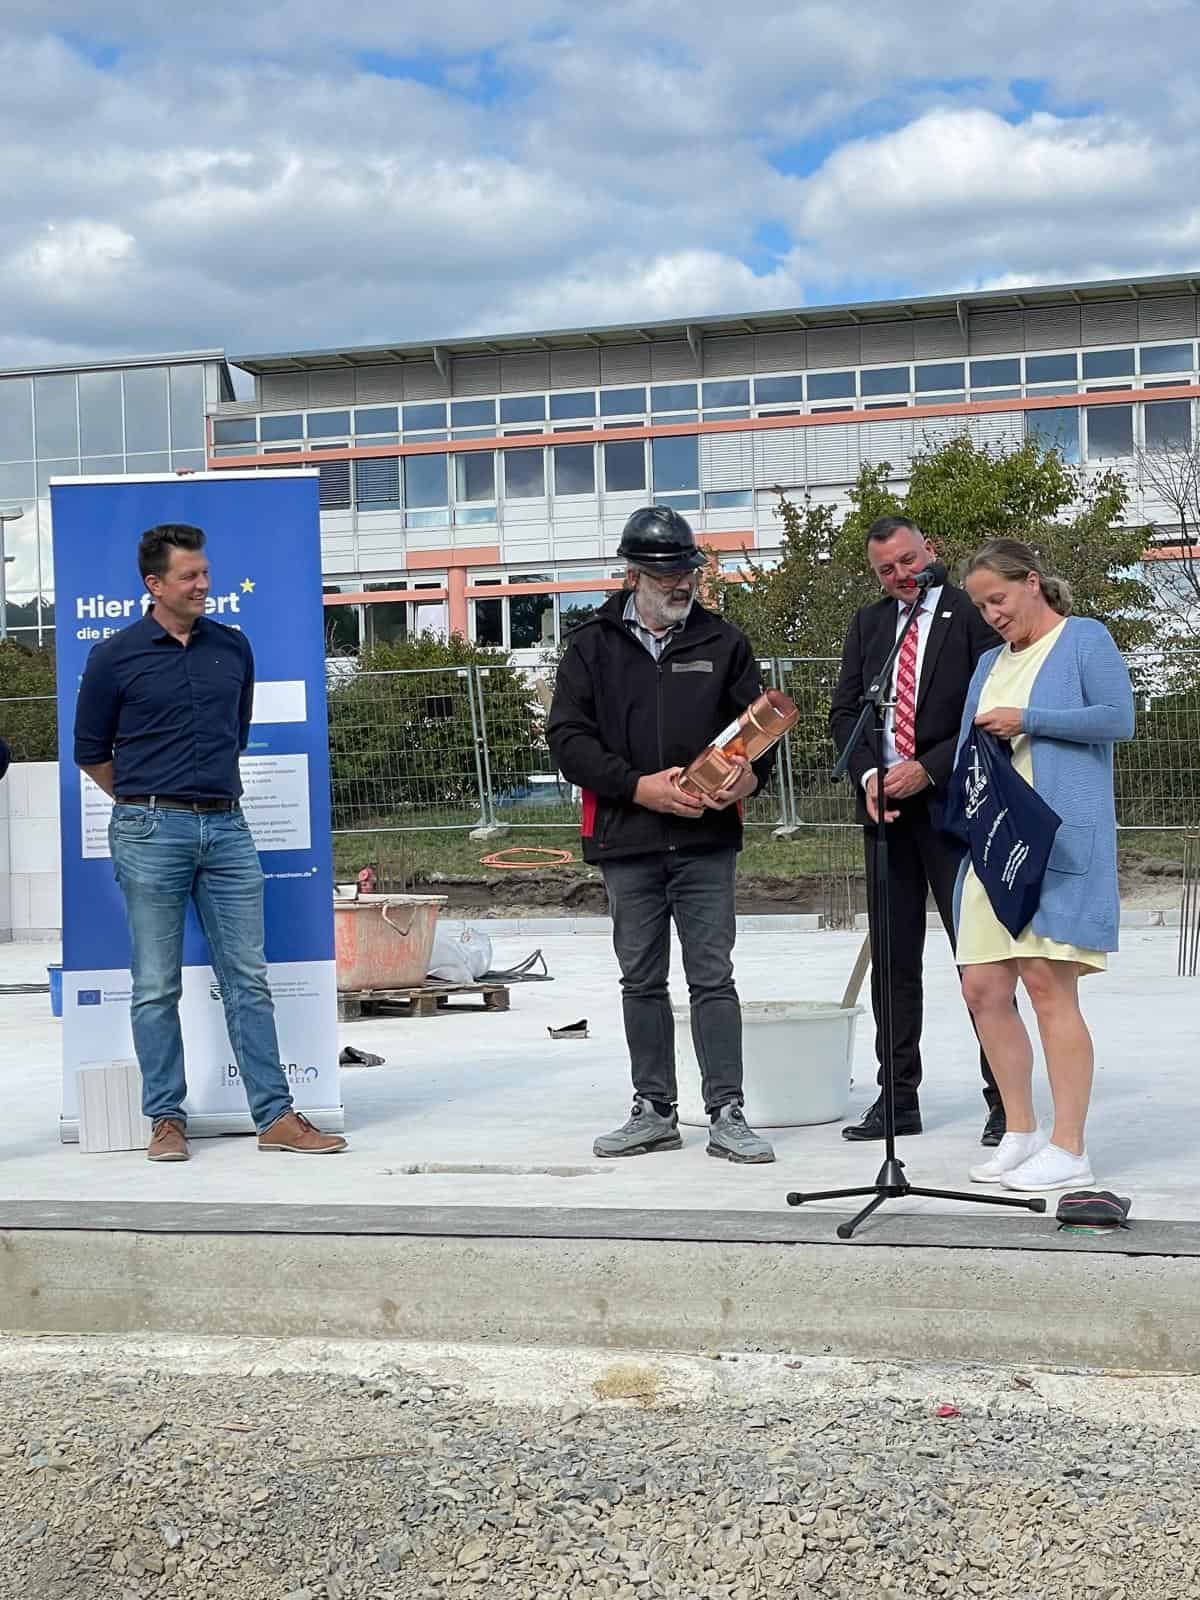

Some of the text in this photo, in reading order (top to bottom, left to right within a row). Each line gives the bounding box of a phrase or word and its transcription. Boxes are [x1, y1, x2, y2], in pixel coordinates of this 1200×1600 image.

[76, 592, 240, 619] Hier fert
[76, 627, 100, 640] die
